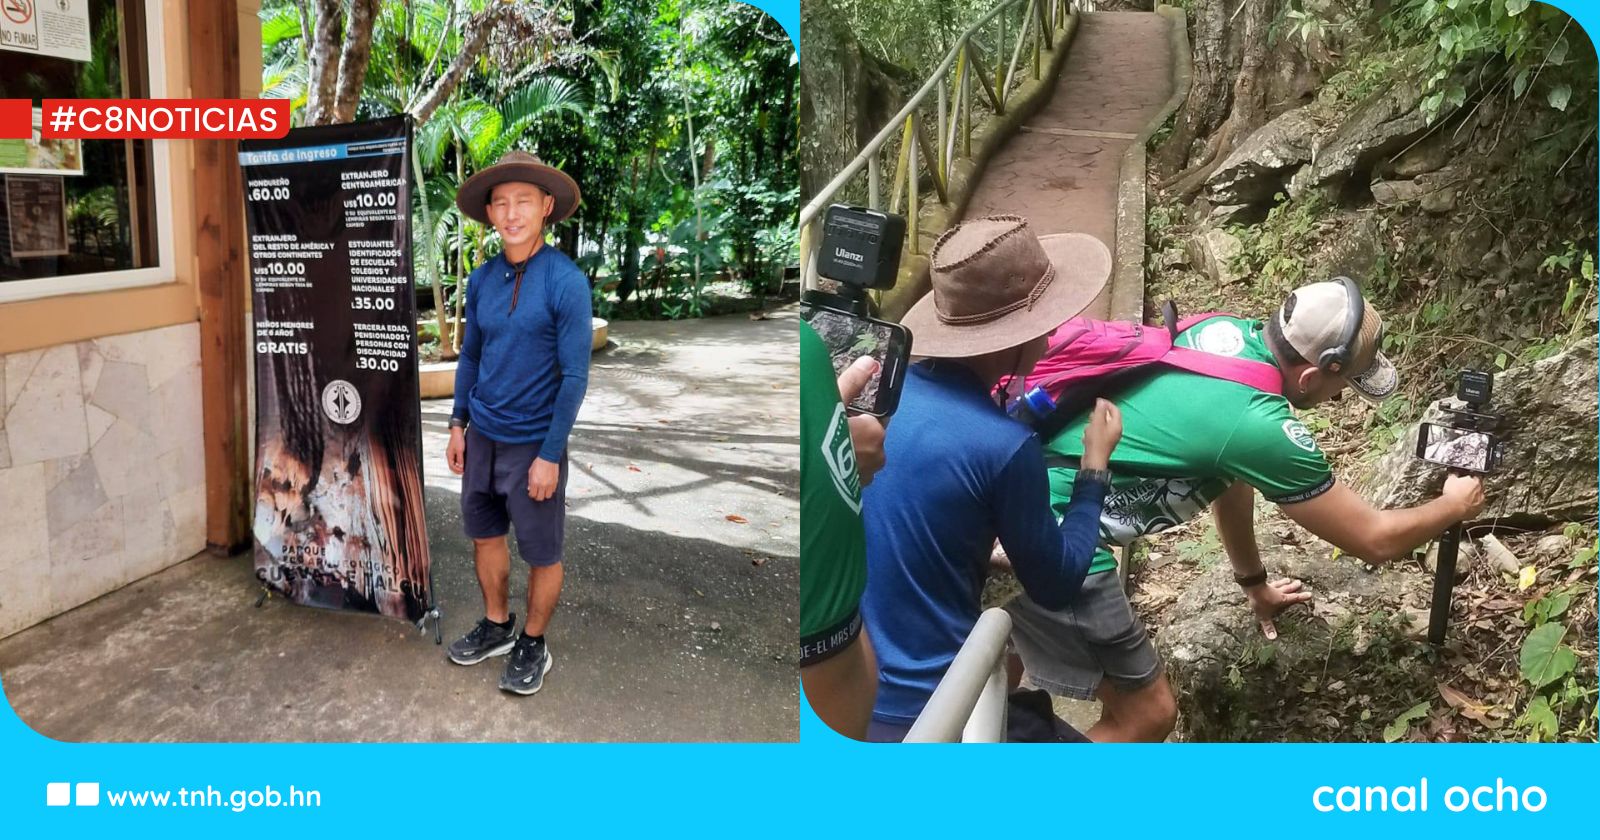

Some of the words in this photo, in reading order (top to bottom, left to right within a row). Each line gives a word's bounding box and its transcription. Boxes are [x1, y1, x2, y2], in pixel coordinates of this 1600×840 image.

[1, 30, 12, 42] NO
[14, 32, 38, 46] FUMAR
[247, 152, 279, 164] Tarifa
[281, 148, 295, 161] de
[341, 169, 389, 181] EXTRANJERO
[248, 176, 290, 187] HONDUREÑO
[252, 234, 297, 242] EXTRANJERO
[290, 242, 300, 250] DE
[300, 241, 329, 250] AMÉRICA
[329, 242, 335, 250] Y
[348, 240, 394, 248] ESTUDIANTES
[253, 251, 276, 259] OTROS
[277, 251, 323, 259] CONTINENTES
[835, 247, 864, 262] Ulanzi
[350, 258, 360, 266] DE
[361, 258, 398, 267] ESCUELAS,
[351, 267, 384, 275] COLEGIOS
[384, 267, 390, 275] Y
[351, 276, 408, 284] UNIVERSIDADES
[351, 285, 396, 293] NACIONALES
[256, 320, 280, 329] NIÑOS
[280, 321, 314, 329] MENORES
[353, 323, 386, 331] TERCERA
[387, 324, 410, 333] EDAD,
[275, 328, 294, 337] AÑOS
[354, 331, 405, 341] PENSIONADOS
[256, 342, 308, 355] GRATIS
[355, 340, 393, 349] PERSONAS
[393, 342, 410, 350] CON
[356, 348, 407, 358] DISCAPACIDAD
